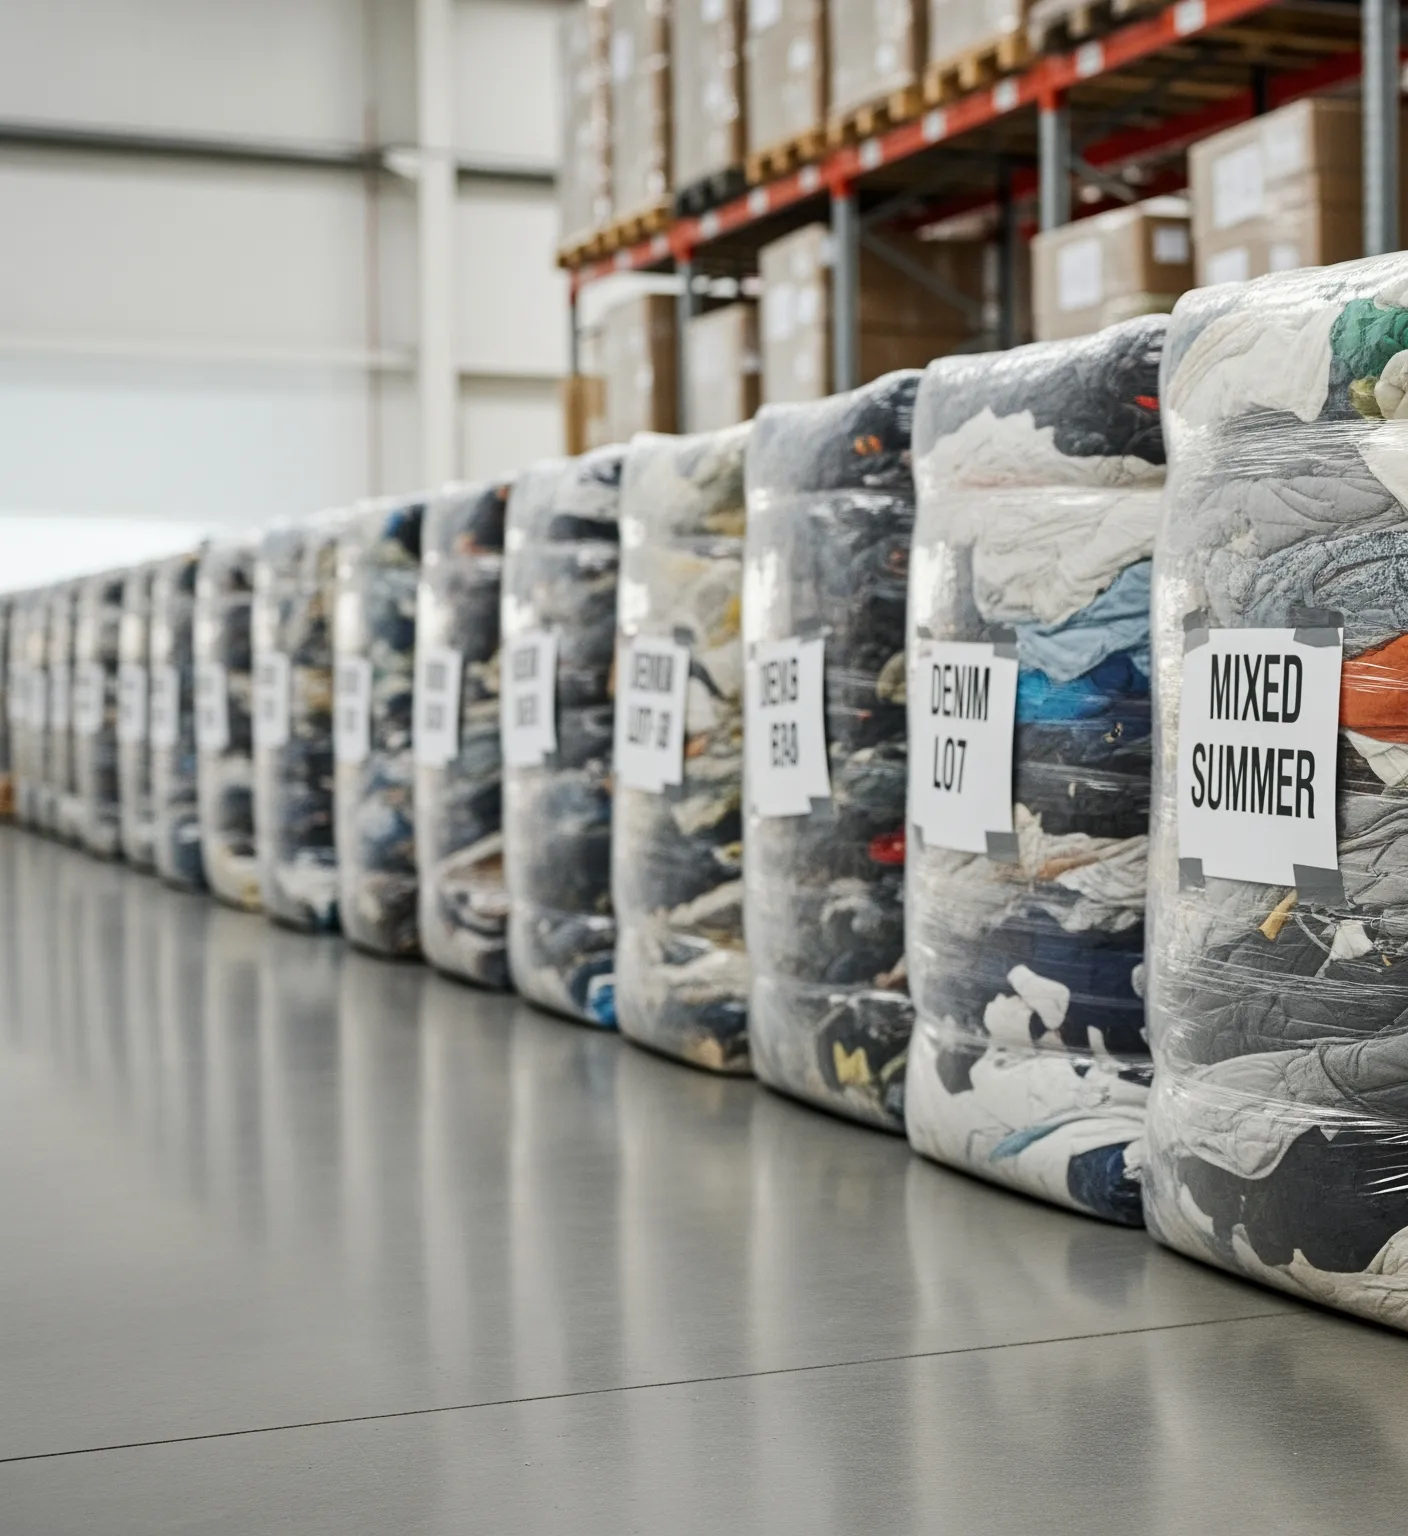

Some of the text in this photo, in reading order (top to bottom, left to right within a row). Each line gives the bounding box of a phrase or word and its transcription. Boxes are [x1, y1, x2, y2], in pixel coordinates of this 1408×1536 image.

[931, 664, 990, 721] DENIM
[1210, 654, 1303, 724] MIXED
[1191, 743, 1316, 819] SUMMER
